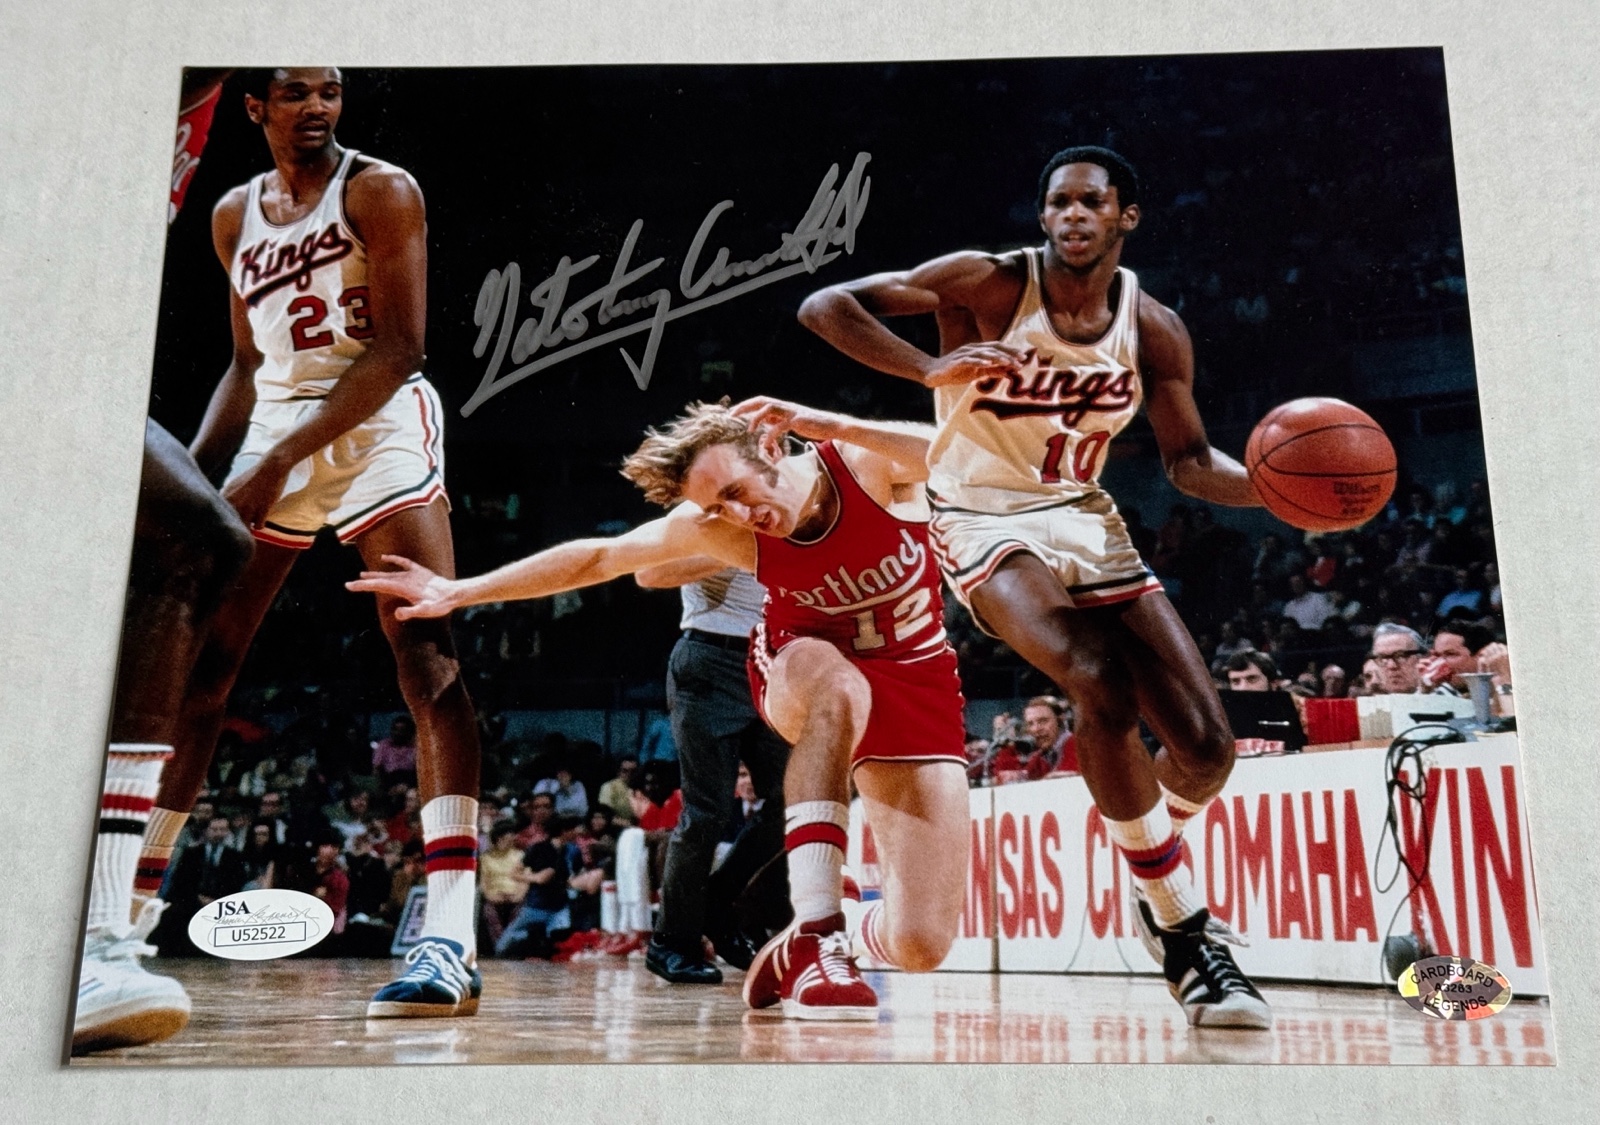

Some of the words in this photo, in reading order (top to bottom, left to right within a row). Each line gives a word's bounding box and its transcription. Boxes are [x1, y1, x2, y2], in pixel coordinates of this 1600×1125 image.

[237, 222, 353, 304] Kings
[287, 285, 375, 353] 23
[1041, 430, 1111, 484] 10
[852, 587, 934, 651] 12
[1204, 788, 1379, 942] OMAHA
[1395, 765, 1540, 968] KIN
[214, 900, 250, 920] JSA
[231, 925, 286, 942] U52522
[1410, 964, 1494, 988] CARDBOARD
[1423, 995, 1488, 1012] LEGENDS
